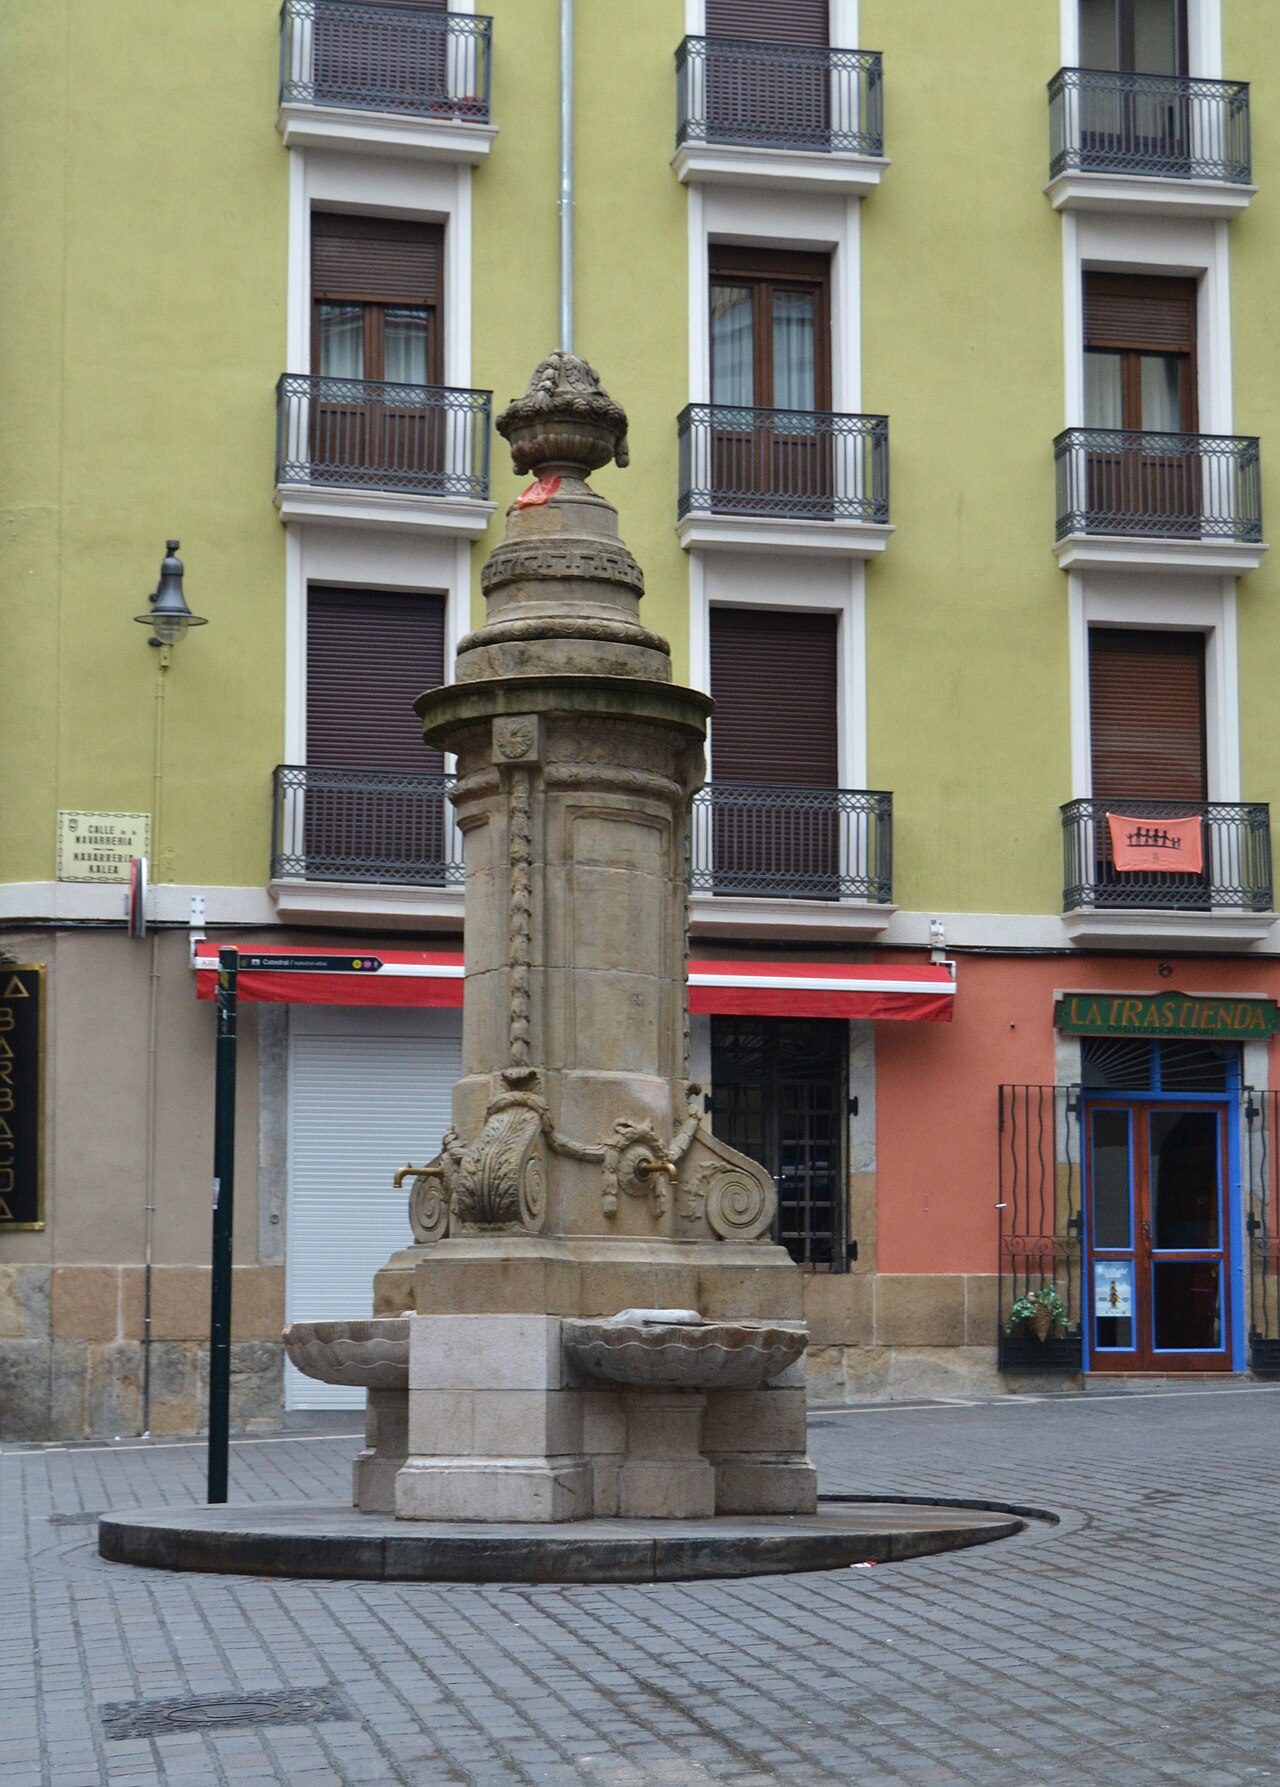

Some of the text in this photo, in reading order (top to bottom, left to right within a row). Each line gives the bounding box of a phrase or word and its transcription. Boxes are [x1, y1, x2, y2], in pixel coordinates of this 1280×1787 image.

[88, 825, 115, 834] CALLE
[75, 835, 133, 846] NAVARRERIA
[89, 864, 119, 874] KALEA
[1070, 998, 1266, 1031] LA TRASTIENDA
